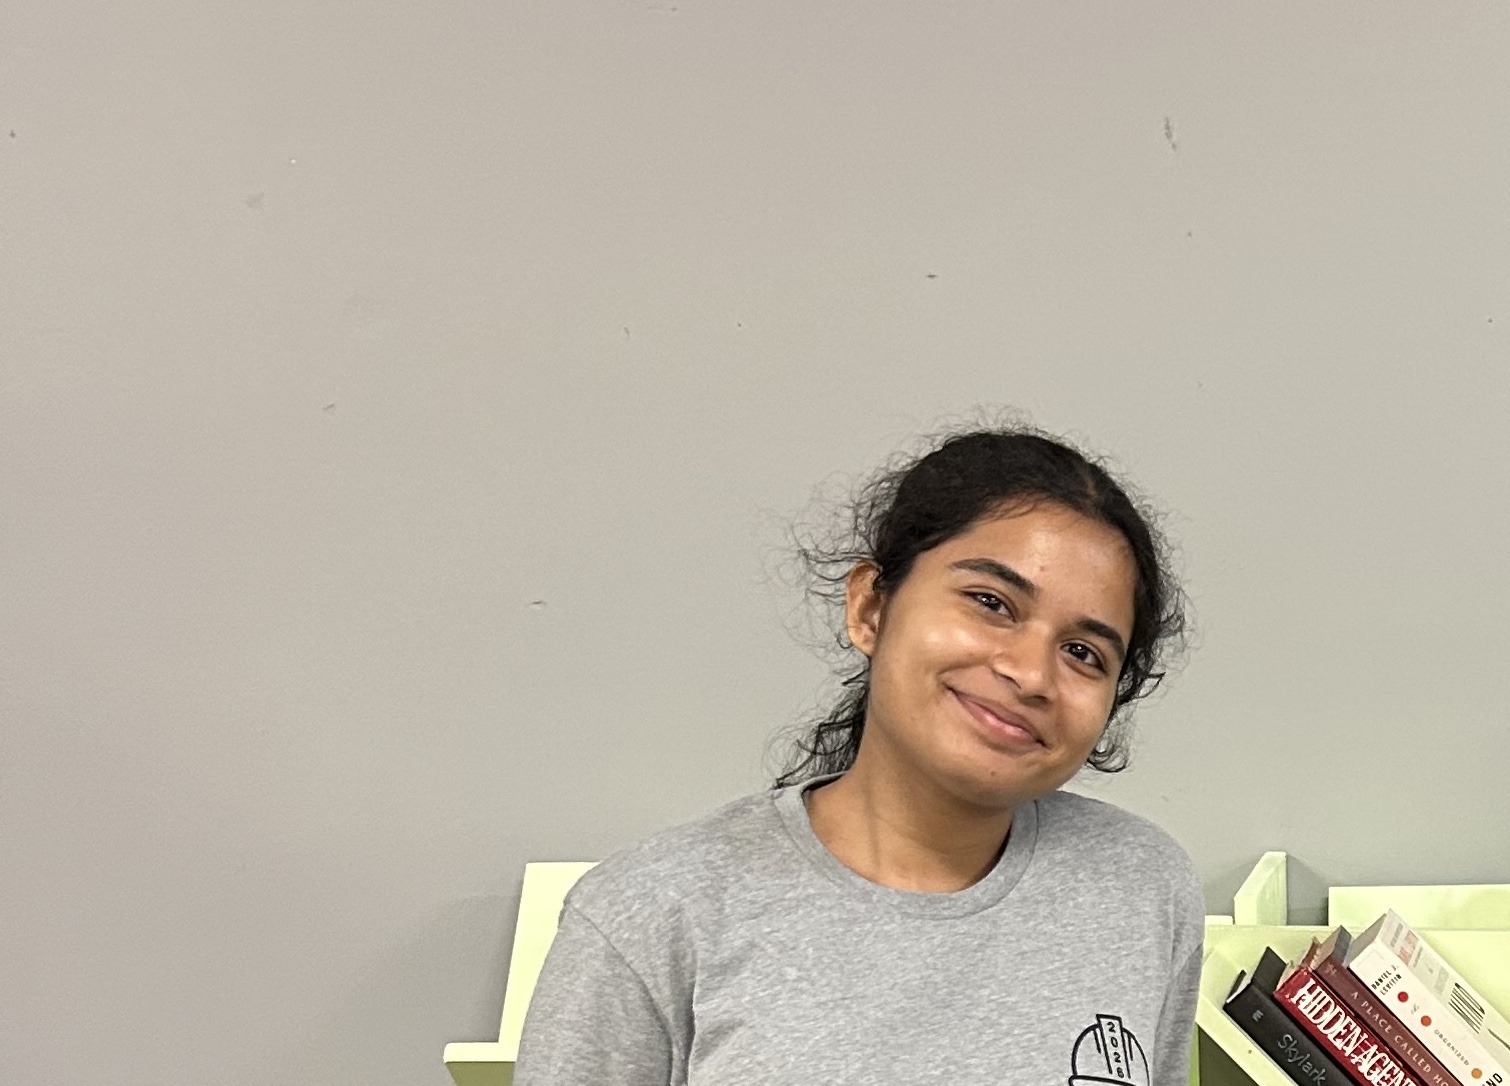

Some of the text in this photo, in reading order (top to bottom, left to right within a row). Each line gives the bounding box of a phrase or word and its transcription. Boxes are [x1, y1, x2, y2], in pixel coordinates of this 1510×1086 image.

[1288, 978, 1369, 1057] HIDDEN
[1351, 991, 1359, 1000] A
[1361, 1000, 1393, 1034] PLACE
[1394, 1034, 1432, 1074] CALLED
[1278, 1034, 1326, 1086] Skylark
